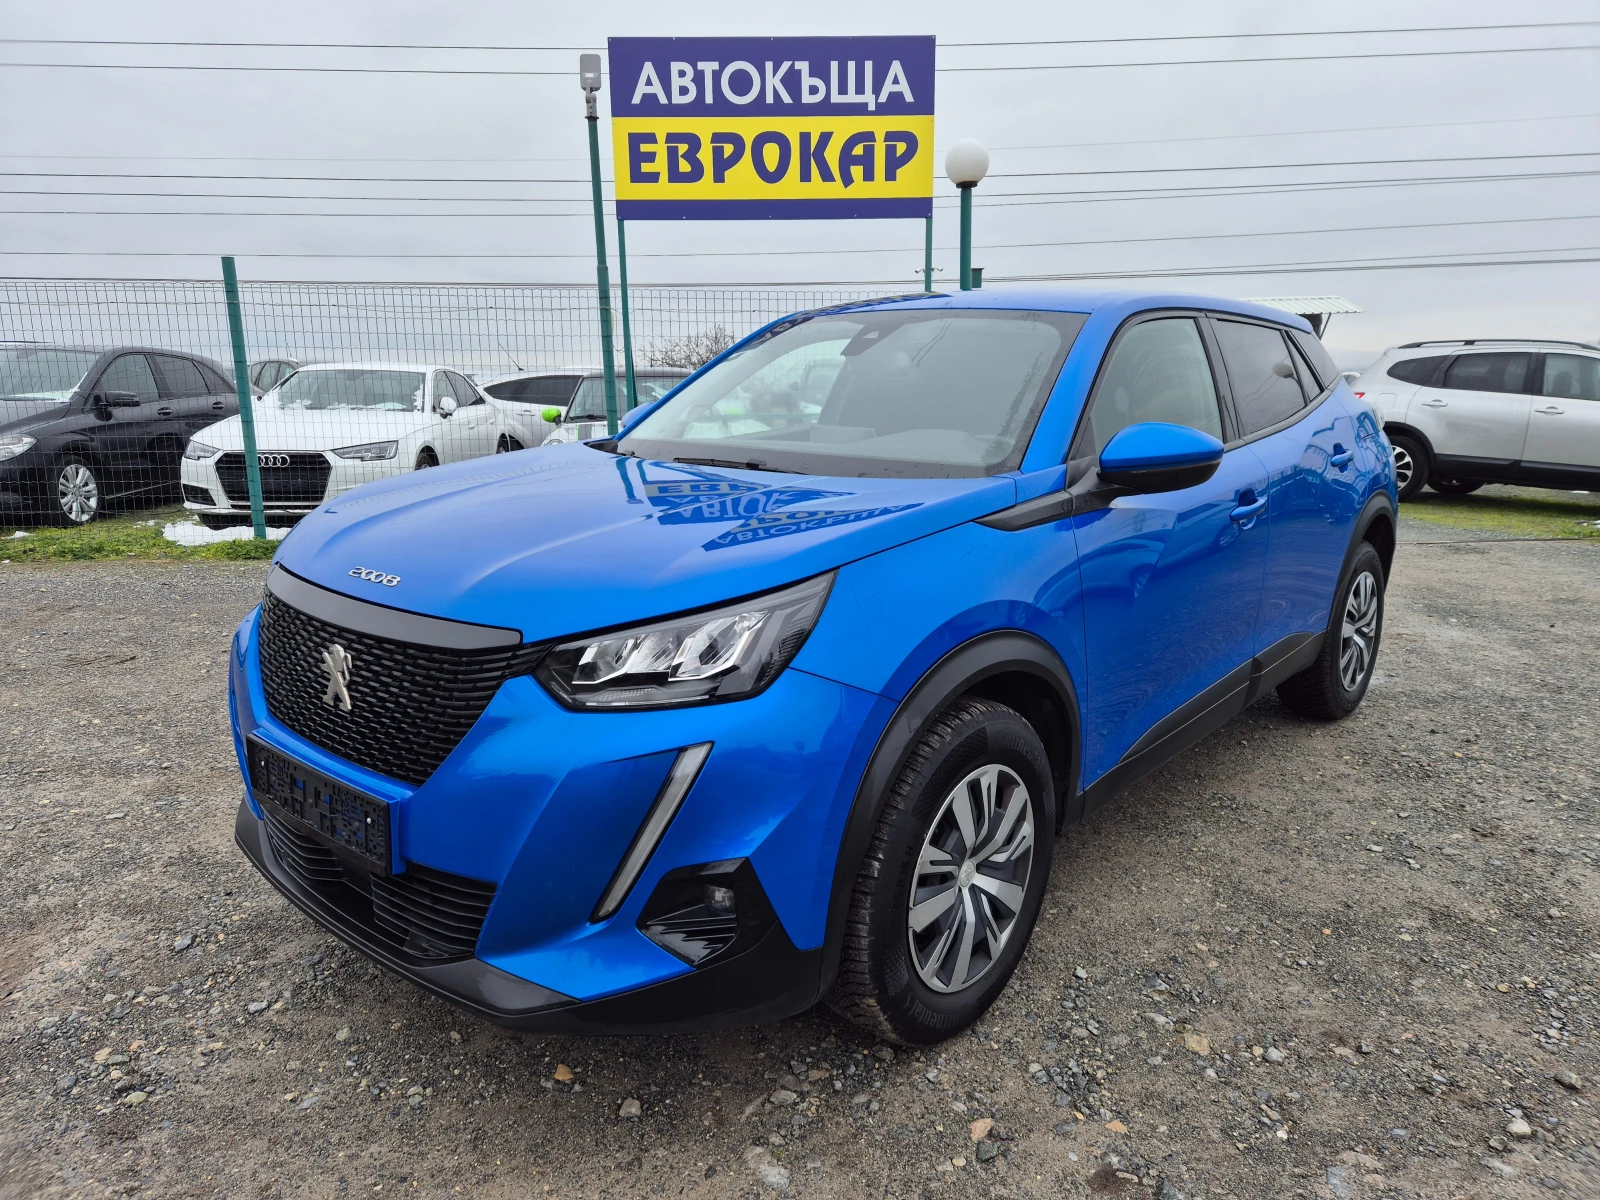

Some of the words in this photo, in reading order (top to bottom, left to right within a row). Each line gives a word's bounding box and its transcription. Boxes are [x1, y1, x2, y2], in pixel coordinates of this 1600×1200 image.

[631, 60, 915, 111] АВТОКЪЩА
[627, 130, 919, 189] ЕВРОКАР
[348, 566, 402, 587] 2008
